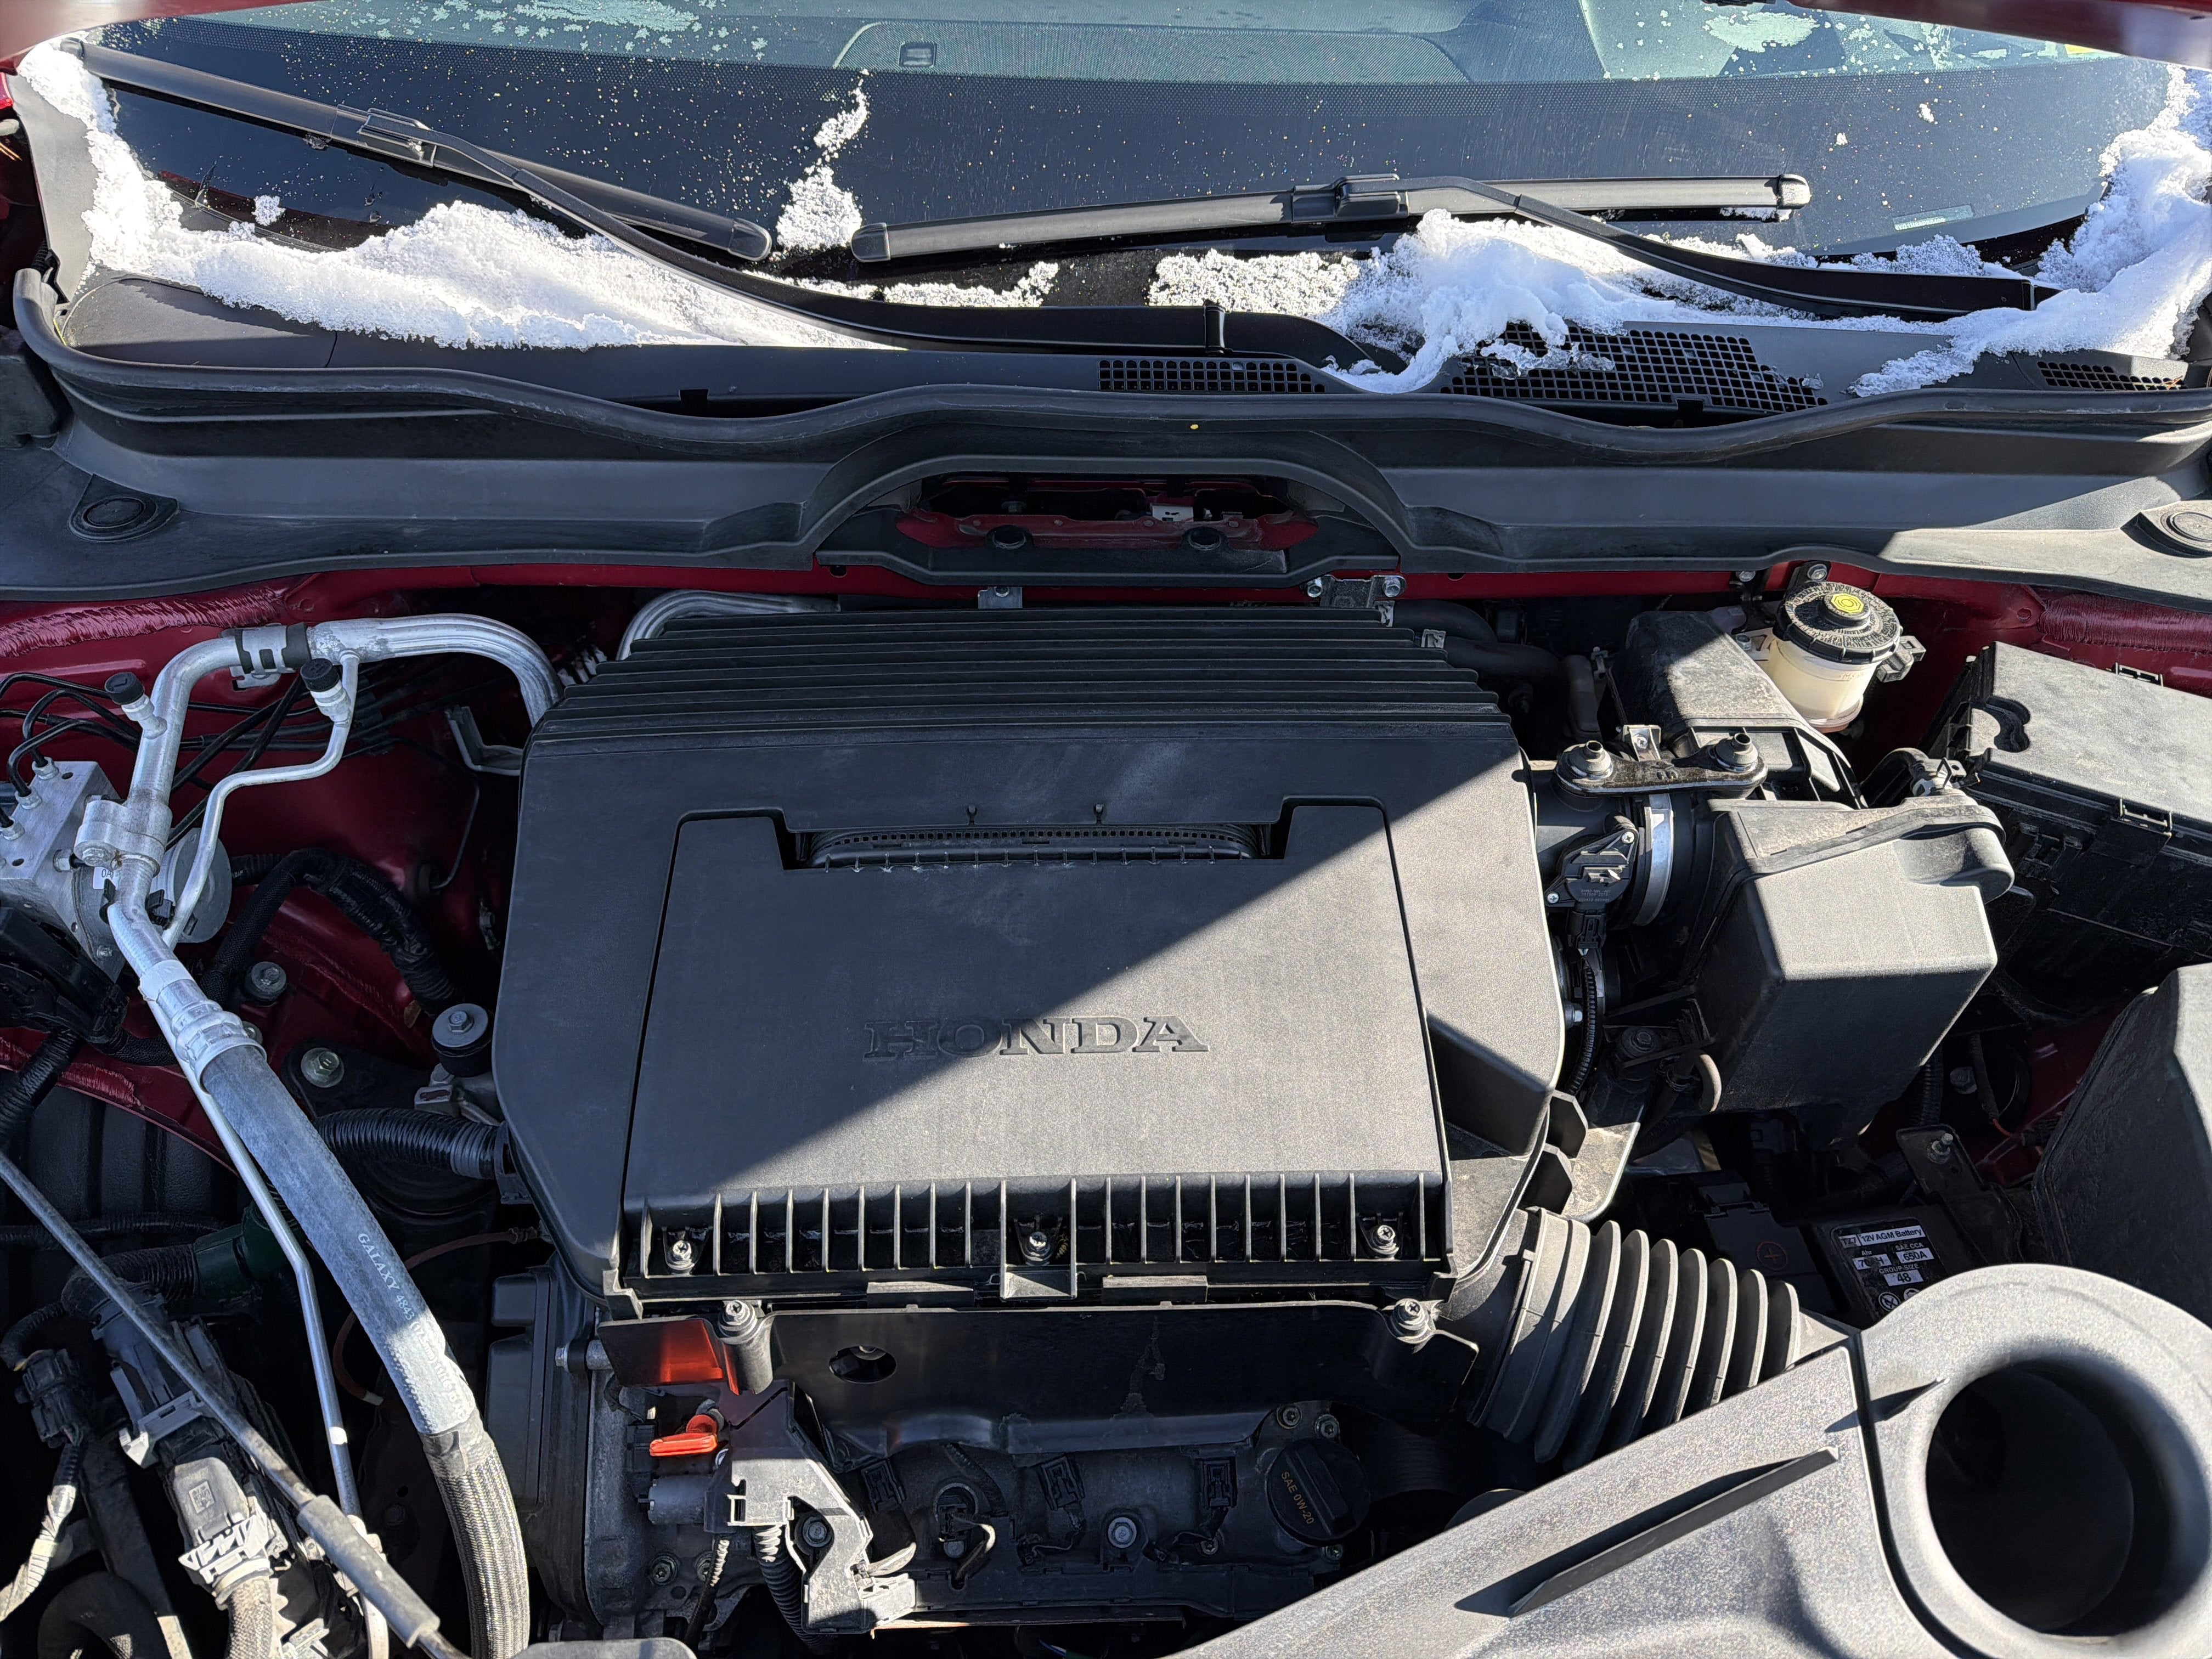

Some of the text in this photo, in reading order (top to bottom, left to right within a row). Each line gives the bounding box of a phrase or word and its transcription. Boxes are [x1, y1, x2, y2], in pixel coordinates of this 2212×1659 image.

[863, 1016, 1210, 1060] HONDA
[1876, 1233, 1894, 1241] AGM
[1895, 1229, 1922, 1238] Battery
[1903, 1251, 1927, 1261] 650A
[1879, 1266, 1902, 1274] GROUP
[358, 1233, 400, 1290] GALAXY
[396, 1295, 415, 1320] 4843
[1898, 1273, 1911, 1283] 48
[1281, 1472, 1314, 1524] SAE 0W-20
